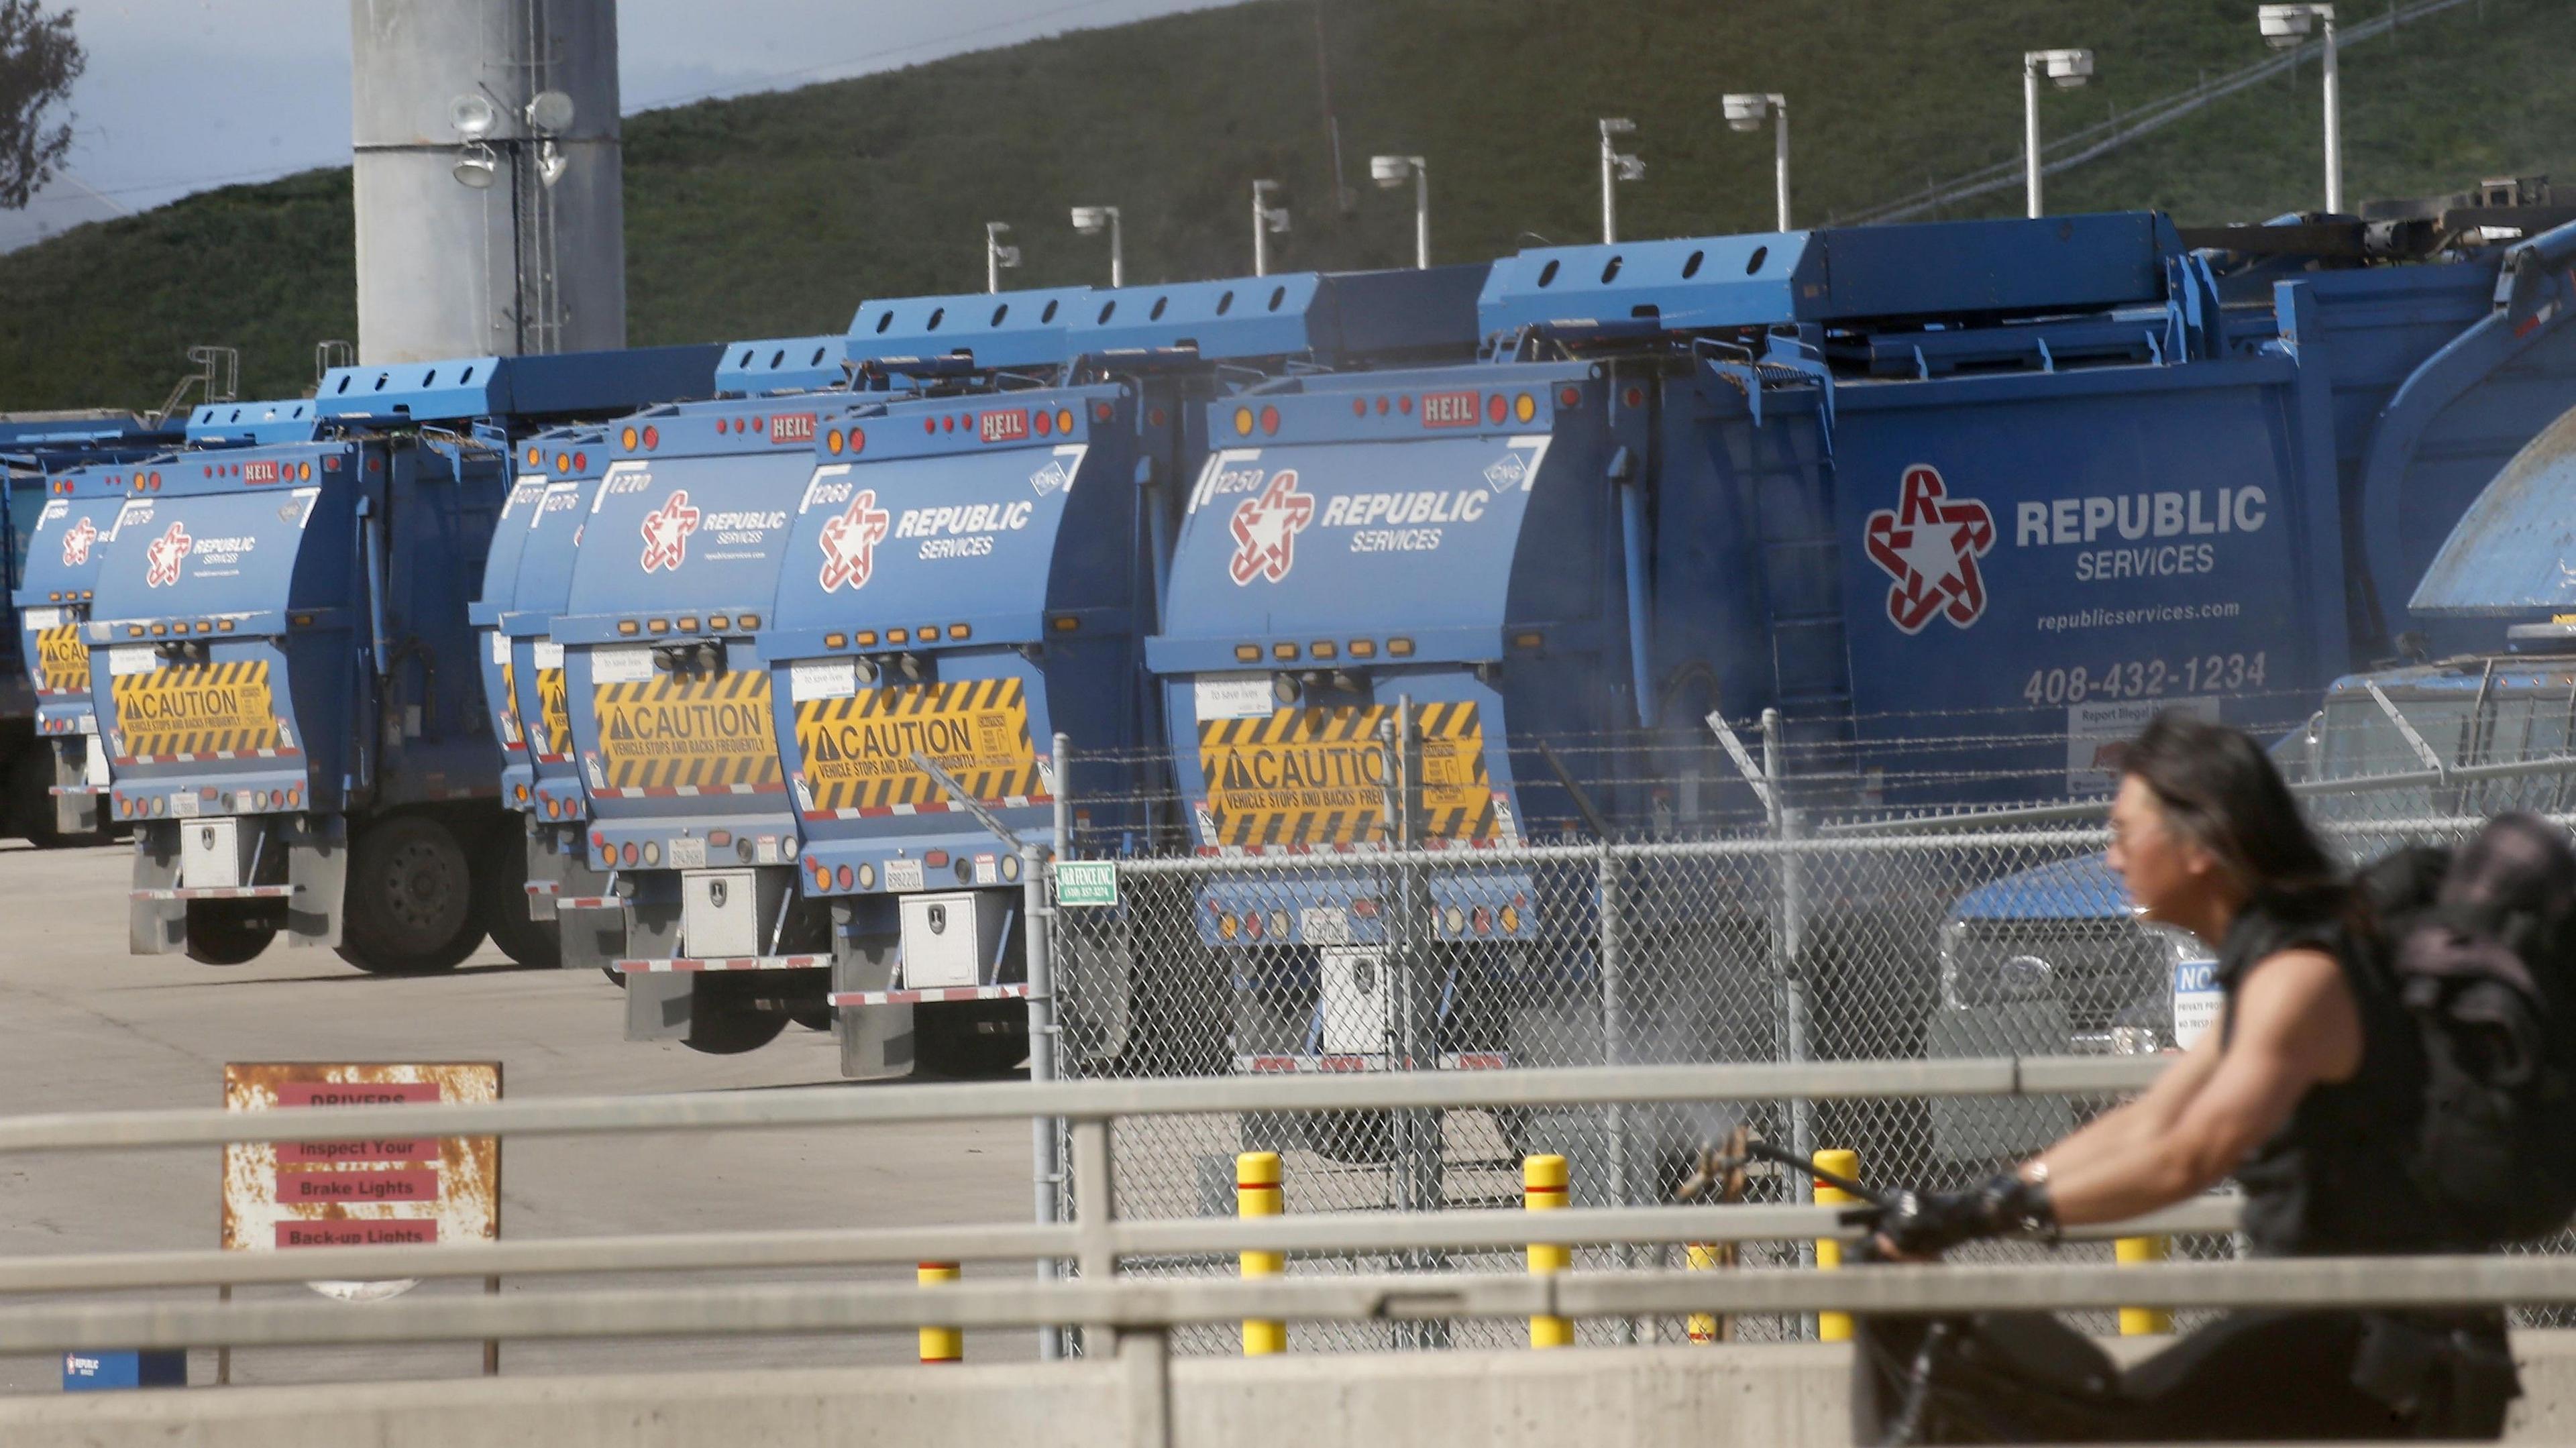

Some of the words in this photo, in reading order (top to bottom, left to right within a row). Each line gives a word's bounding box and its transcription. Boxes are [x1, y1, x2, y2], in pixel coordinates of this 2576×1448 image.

[1426, 399, 1473, 421] HEIL
[773, 417, 811, 439] HEIL
[983, 412, 1024, 435] HEIL
[246, 464, 274, 481] HEIL
[1214, 469, 1263, 494] 1250
[609, 474, 652, 494] 1270
[1321, 489, 1489, 526] REPUBLIC
[2016, 485, 2267, 547] REPUBLIC
[703, 510, 786, 531] REPUBLIC
[895, 500, 1032, 539] REPUBLIC
[193, 537, 256, 554] REPUBLIC
[716, 530, 763, 545] SERVICES
[918, 536, 994, 560] SERVICES
[1350, 528, 1442, 552] SERVICES
[2076, 543, 2214, 581] SERVICES
[2037, 602, 2240, 633] republicservices.com
[2023, 651, 2267, 705] 408-432-1234
[142, 689, 237, 719] CAUTION
[2082, 708, 2115, 722] Report
[635, 704, 761, 739] CAUTION
[612, 740, 645, 756] VEHICLE
[646, 740, 670, 754] STOPS
[672, 739, 687, 753] AND
[688, 739, 714, 753] BACKS
[716, 738, 765, 753] FREQUENTLY
[841, 718, 972, 760] CAUTION
[818, 761, 851, 779] VEHICLE
[853, 759, 879, 777] STOPS
[880, 759, 897, 775] AND
[1254, 746, 1403, 789] CAUTIO
[1226, 792, 1266, 810] VEHICLE
[1268, 791, 1299, 808] STOPS
[1301, 790, 1320, 807] AND
[1324, 789, 1355, 806] BACKS
[301, 1139, 366, 1158] Inspect
[372, 1139, 414, 1155] Your
[301, 1182, 352, 1196] Brake
[358, 1180, 413, 1199] Lights
[289, 1230, 362, 1245] Back-up
[368, 1229, 423, 1243] Lights
